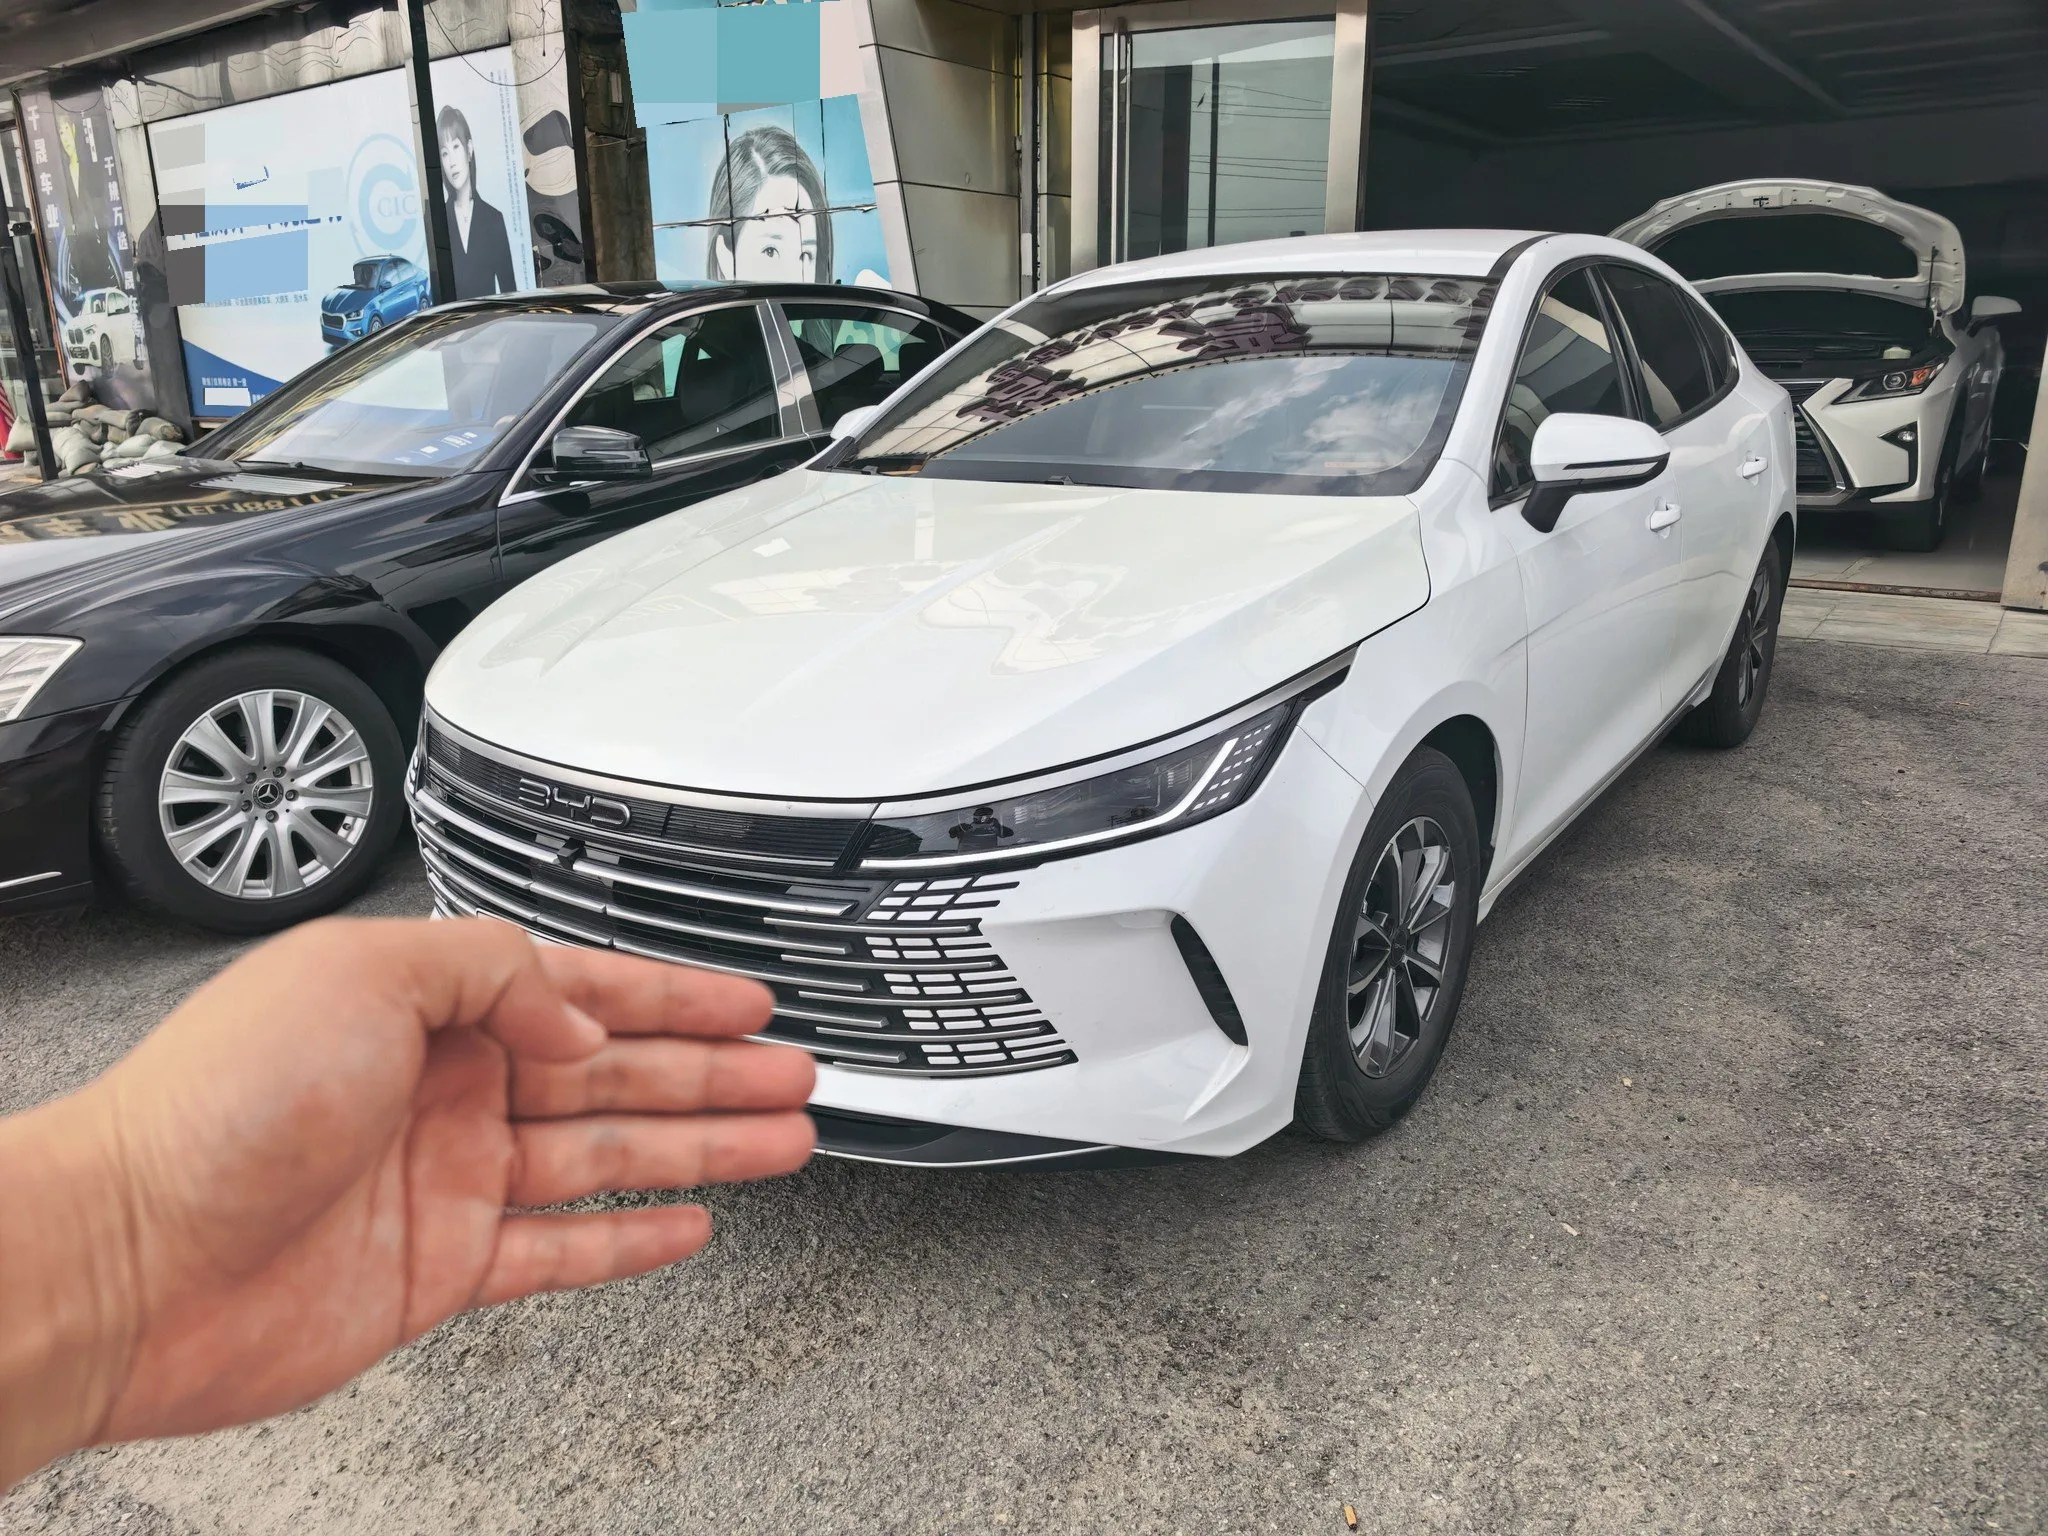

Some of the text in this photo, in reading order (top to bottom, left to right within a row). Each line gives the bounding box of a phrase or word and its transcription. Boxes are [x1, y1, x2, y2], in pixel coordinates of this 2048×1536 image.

[27, 105, 60, 228] 千晟车业
[518, 778, 631, 829] BYD
